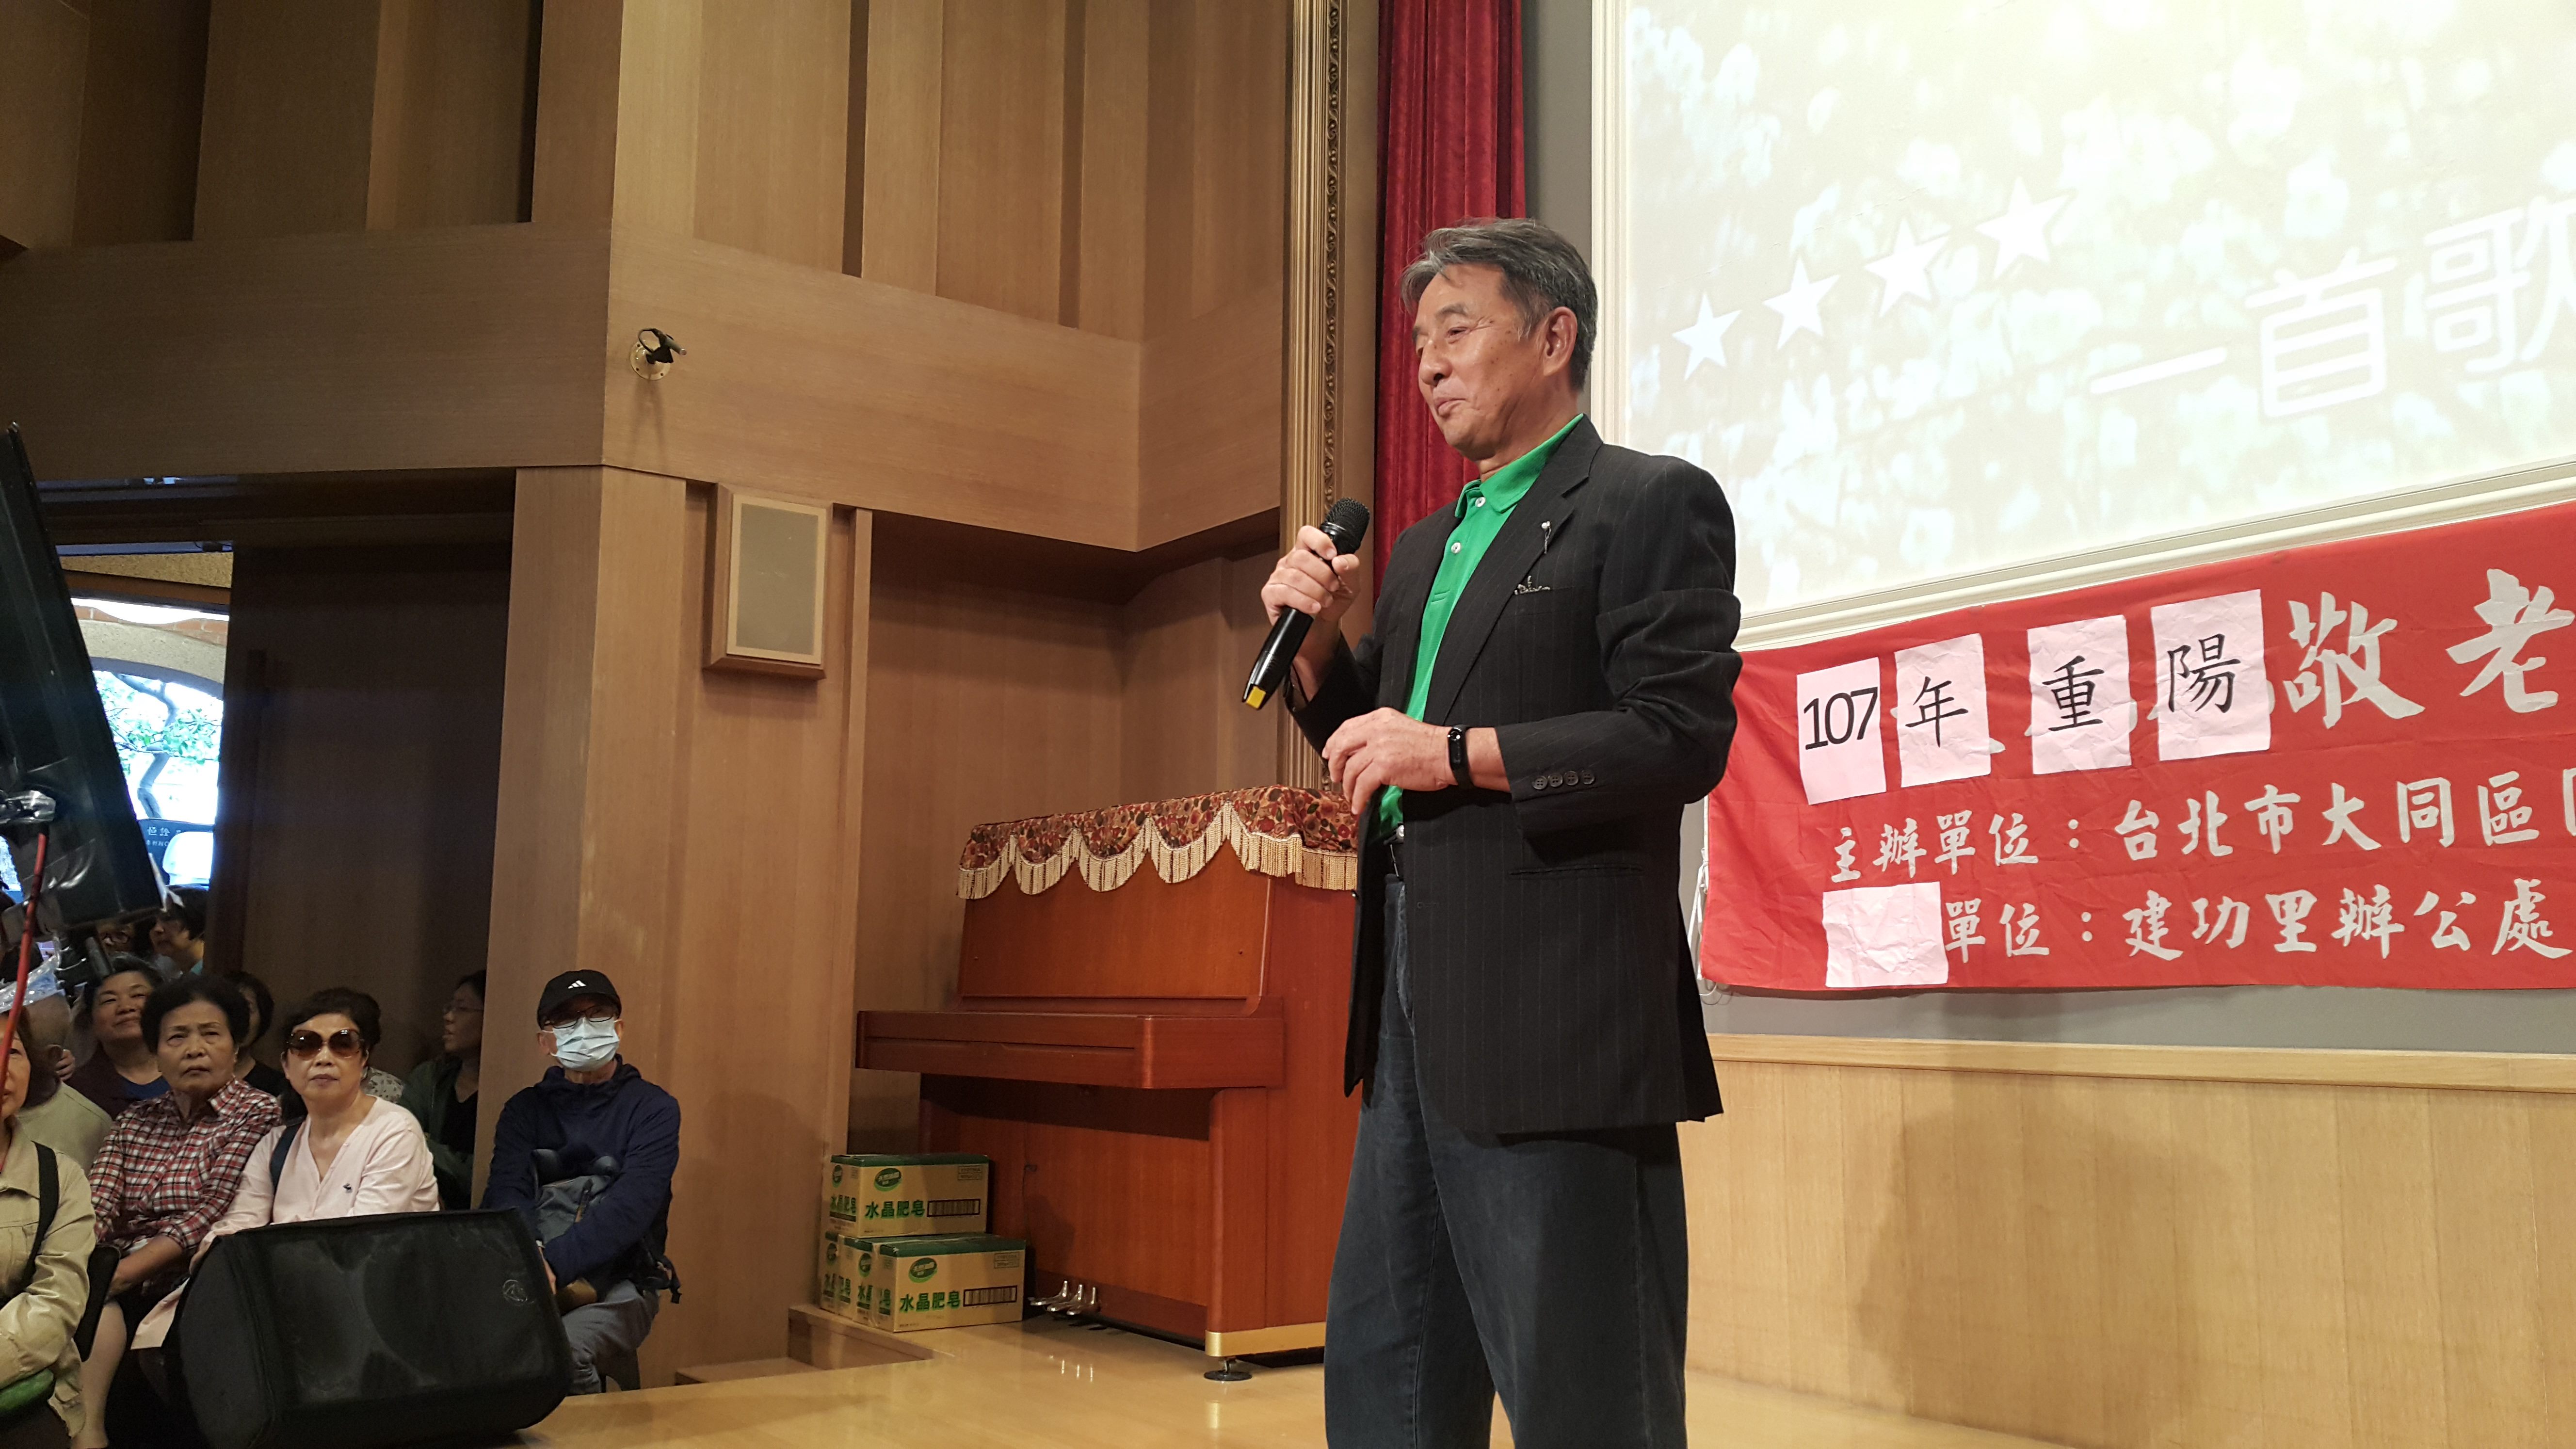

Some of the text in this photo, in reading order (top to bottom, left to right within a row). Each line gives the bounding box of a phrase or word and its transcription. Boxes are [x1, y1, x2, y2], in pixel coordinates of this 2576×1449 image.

[1831, 767, 2576, 883] 主辦單位：台北市大同區
[865, 1199, 925, 1220] 水晶肥皂
[899, 1290, 961, 1313] 水晶肥皂
